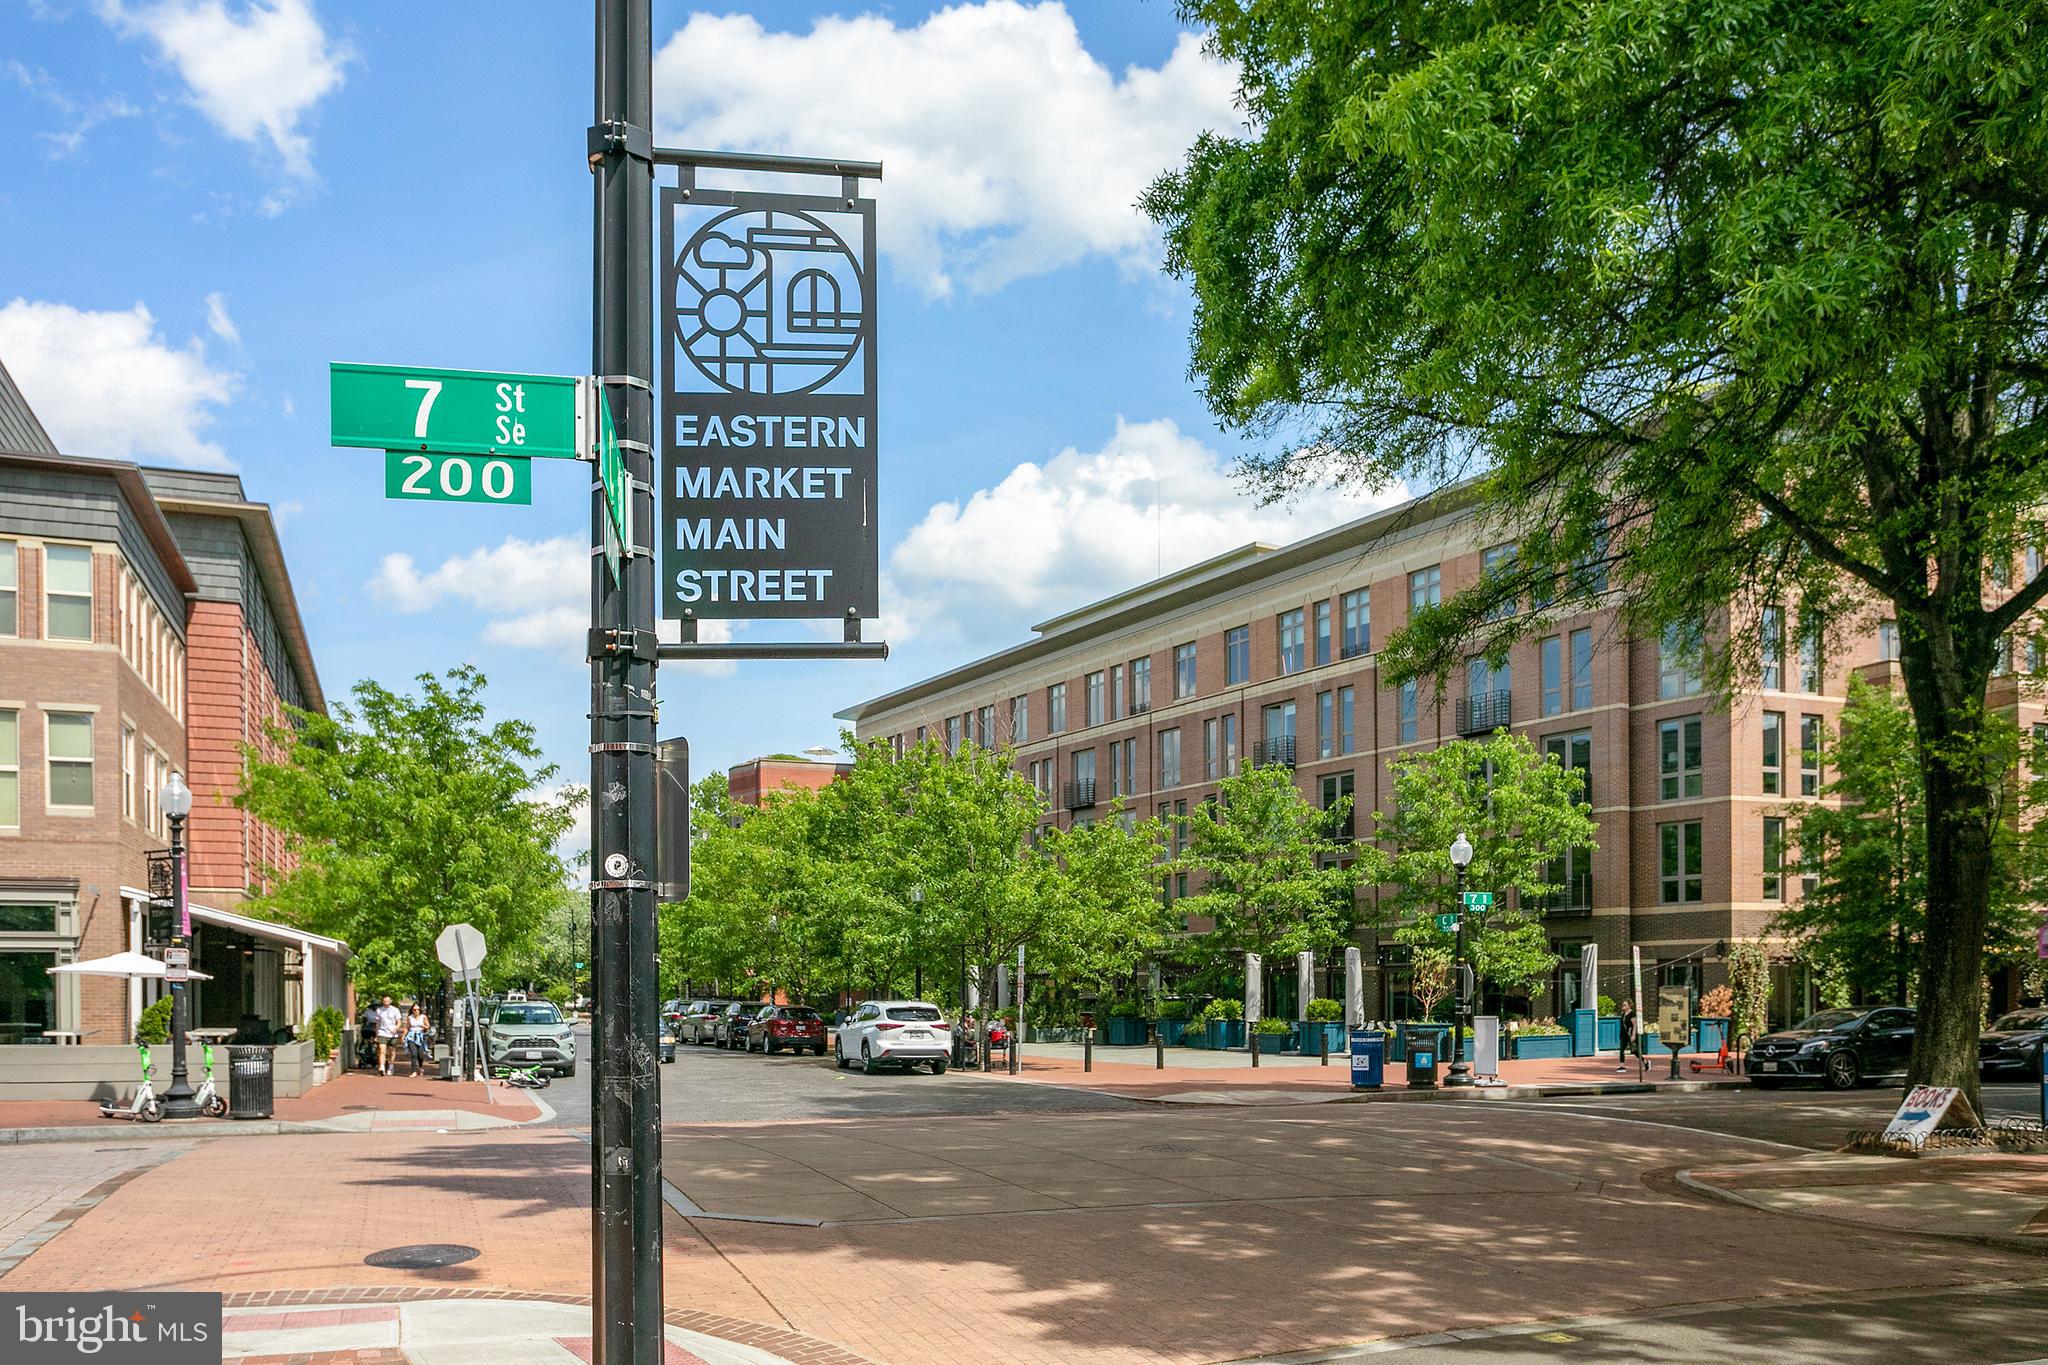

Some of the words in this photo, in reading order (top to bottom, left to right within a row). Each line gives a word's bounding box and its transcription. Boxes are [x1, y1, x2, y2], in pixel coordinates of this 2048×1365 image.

[404, 379, 443, 438] 7
[495, 382, 526, 413] St
[495, 414, 526, 445] Se
[675, 414, 866, 448] EASTERN
[401, 455, 515, 499] 200
[675, 466, 852, 499] MARKET
[675, 517, 786, 550] MAIN
[675, 568, 833, 602] STREET
[1469, 894, 1478, 904] 7
[1442, 915, 1448, 925] C
[1904, 1087, 1952, 1108] BOOKS
